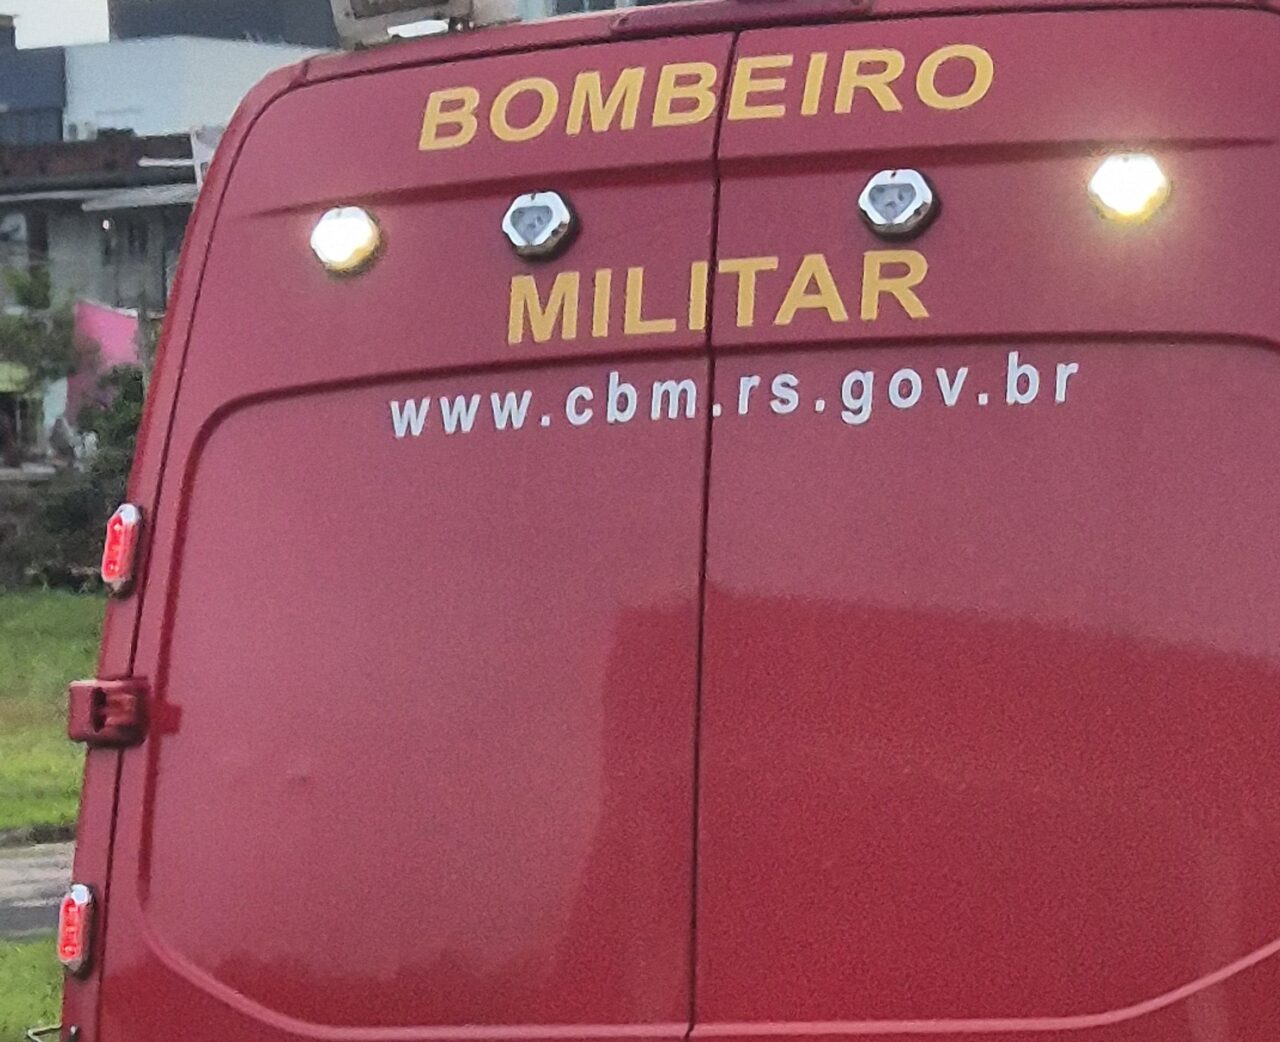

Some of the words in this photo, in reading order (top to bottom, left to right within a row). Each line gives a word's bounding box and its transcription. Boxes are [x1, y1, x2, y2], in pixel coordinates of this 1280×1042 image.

[418, 43, 995, 152] BOMBEIRO
[506, 248, 930, 345] MILITAR
[390, 350, 1080, 439] www.cbm.rs.gov.br
